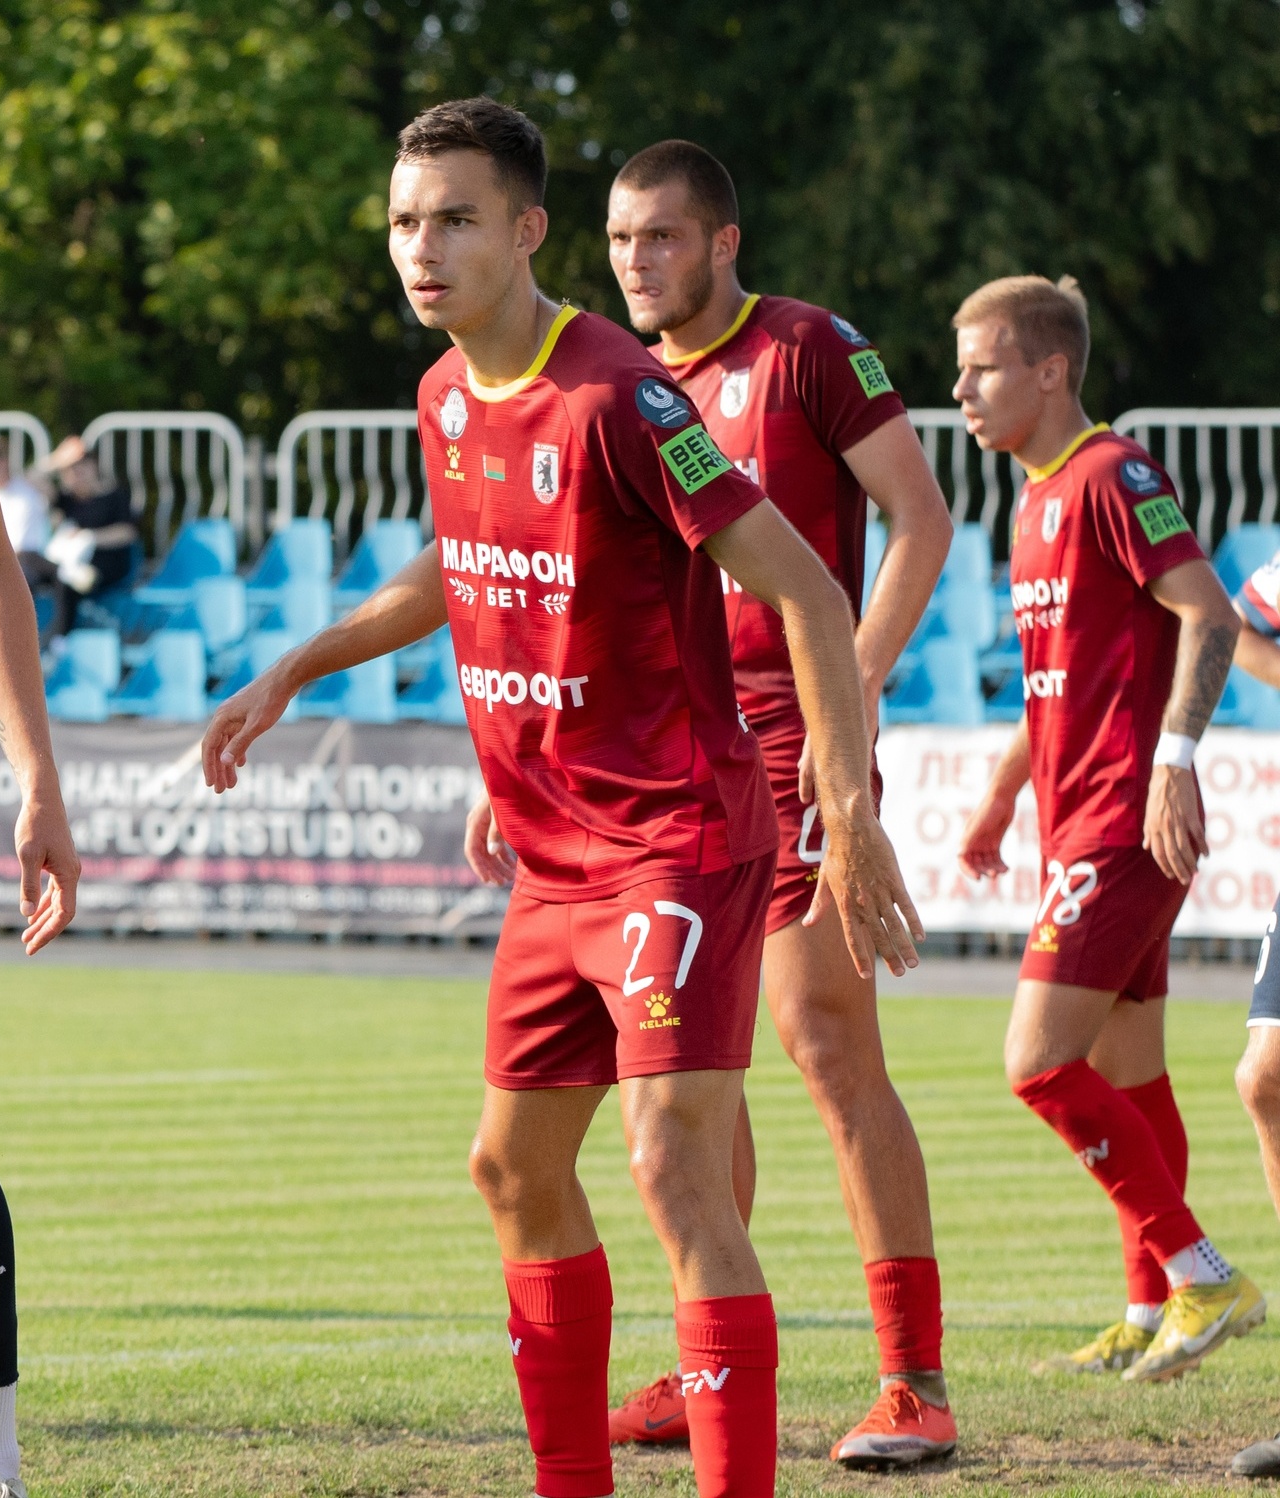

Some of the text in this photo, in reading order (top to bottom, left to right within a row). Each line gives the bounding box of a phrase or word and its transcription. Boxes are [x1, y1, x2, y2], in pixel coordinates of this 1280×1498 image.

[444, 469, 465, 482] KELME
[441, 536, 576, 588] МАРАФОН
[486, 586, 527, 609] БЕТ
[622, 899, 704, 998] 27
[639, 1016, 681, 1031] KELME
